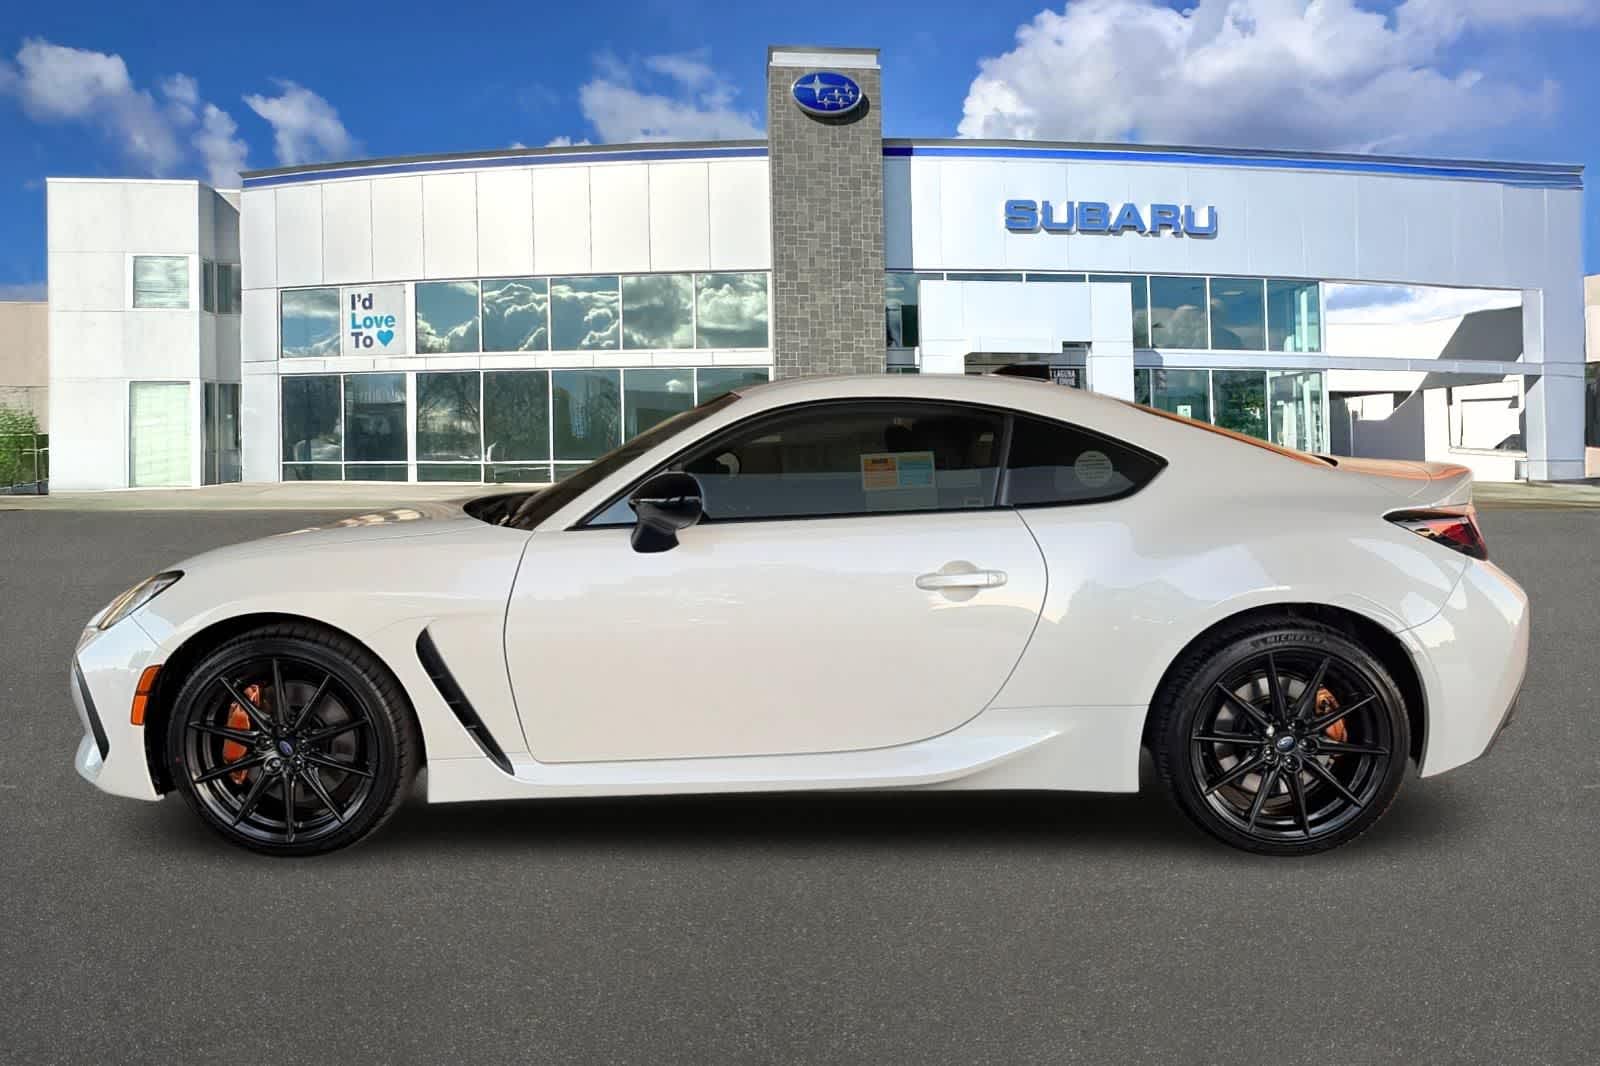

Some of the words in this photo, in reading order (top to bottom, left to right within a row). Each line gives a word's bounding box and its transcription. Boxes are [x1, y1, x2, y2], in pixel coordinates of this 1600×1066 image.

[1005, 200, 1216, 236] SUBARU
[351, 293, 373, 310] I'd
[351, 313, 396, 329] Love
[351, 332, 374, 348] To
